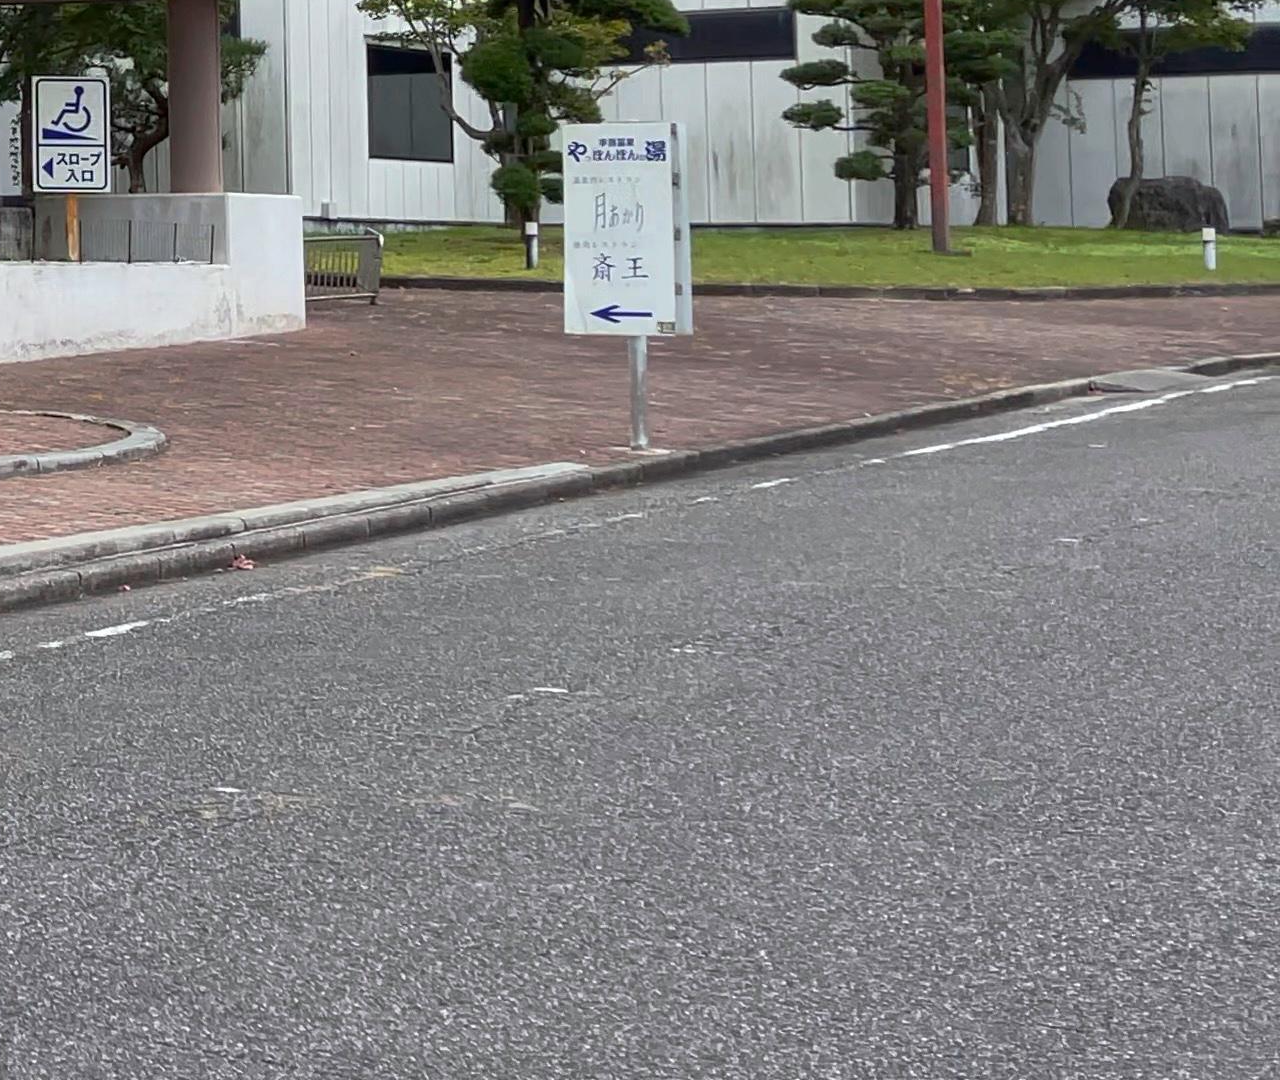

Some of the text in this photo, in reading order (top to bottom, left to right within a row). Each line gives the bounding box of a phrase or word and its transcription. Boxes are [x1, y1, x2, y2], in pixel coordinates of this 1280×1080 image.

[56, 151, 102, 166] スロープ
[65, 169, 94, 183] 入口
